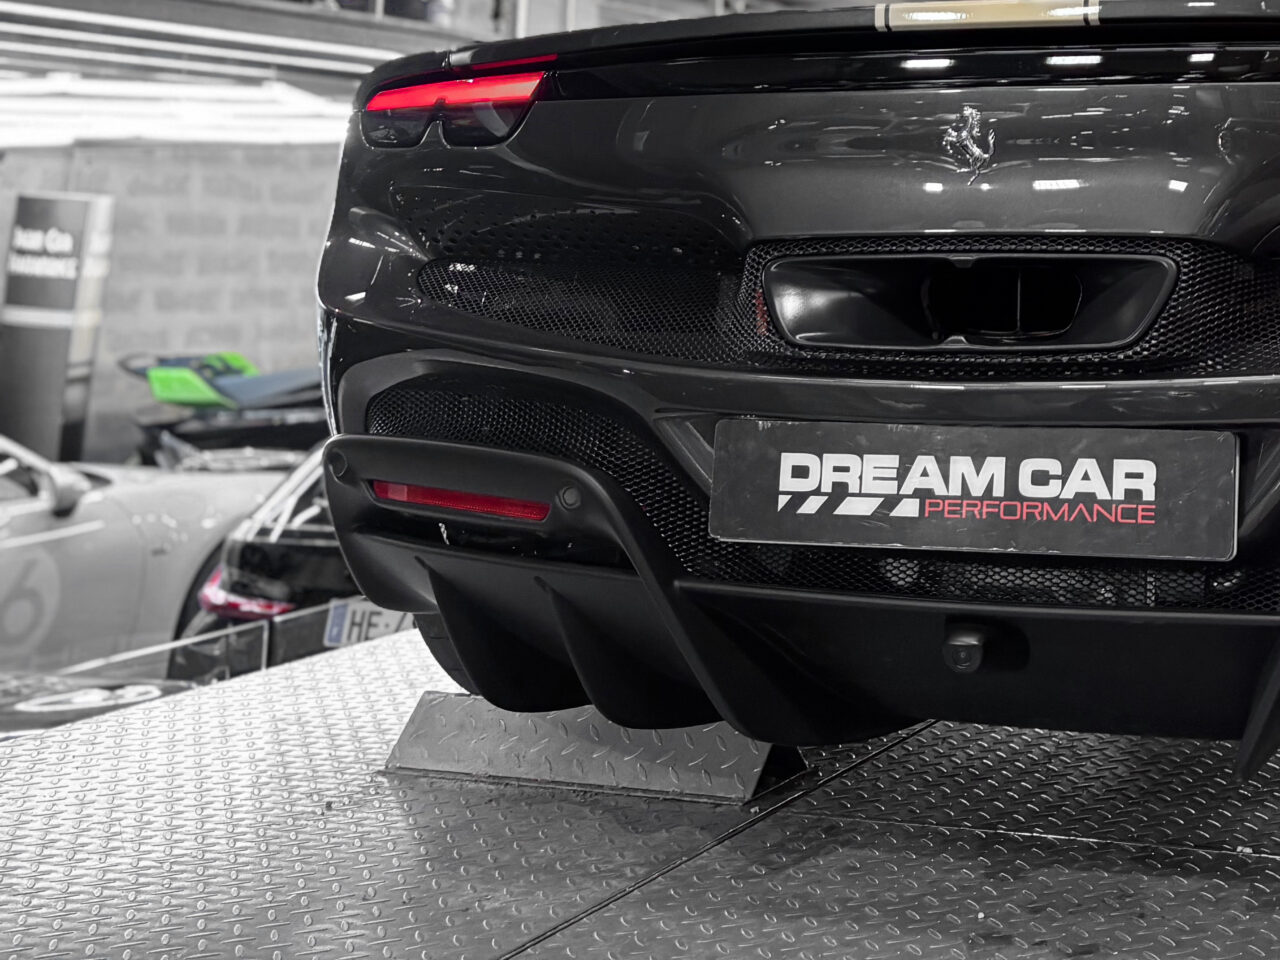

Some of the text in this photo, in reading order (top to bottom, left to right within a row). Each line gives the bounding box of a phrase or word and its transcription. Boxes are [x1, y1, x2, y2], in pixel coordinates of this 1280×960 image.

[778, 452, 1157, 502] DREAM CAR
[924, 499, 1157, 525] PERFORMANCE
